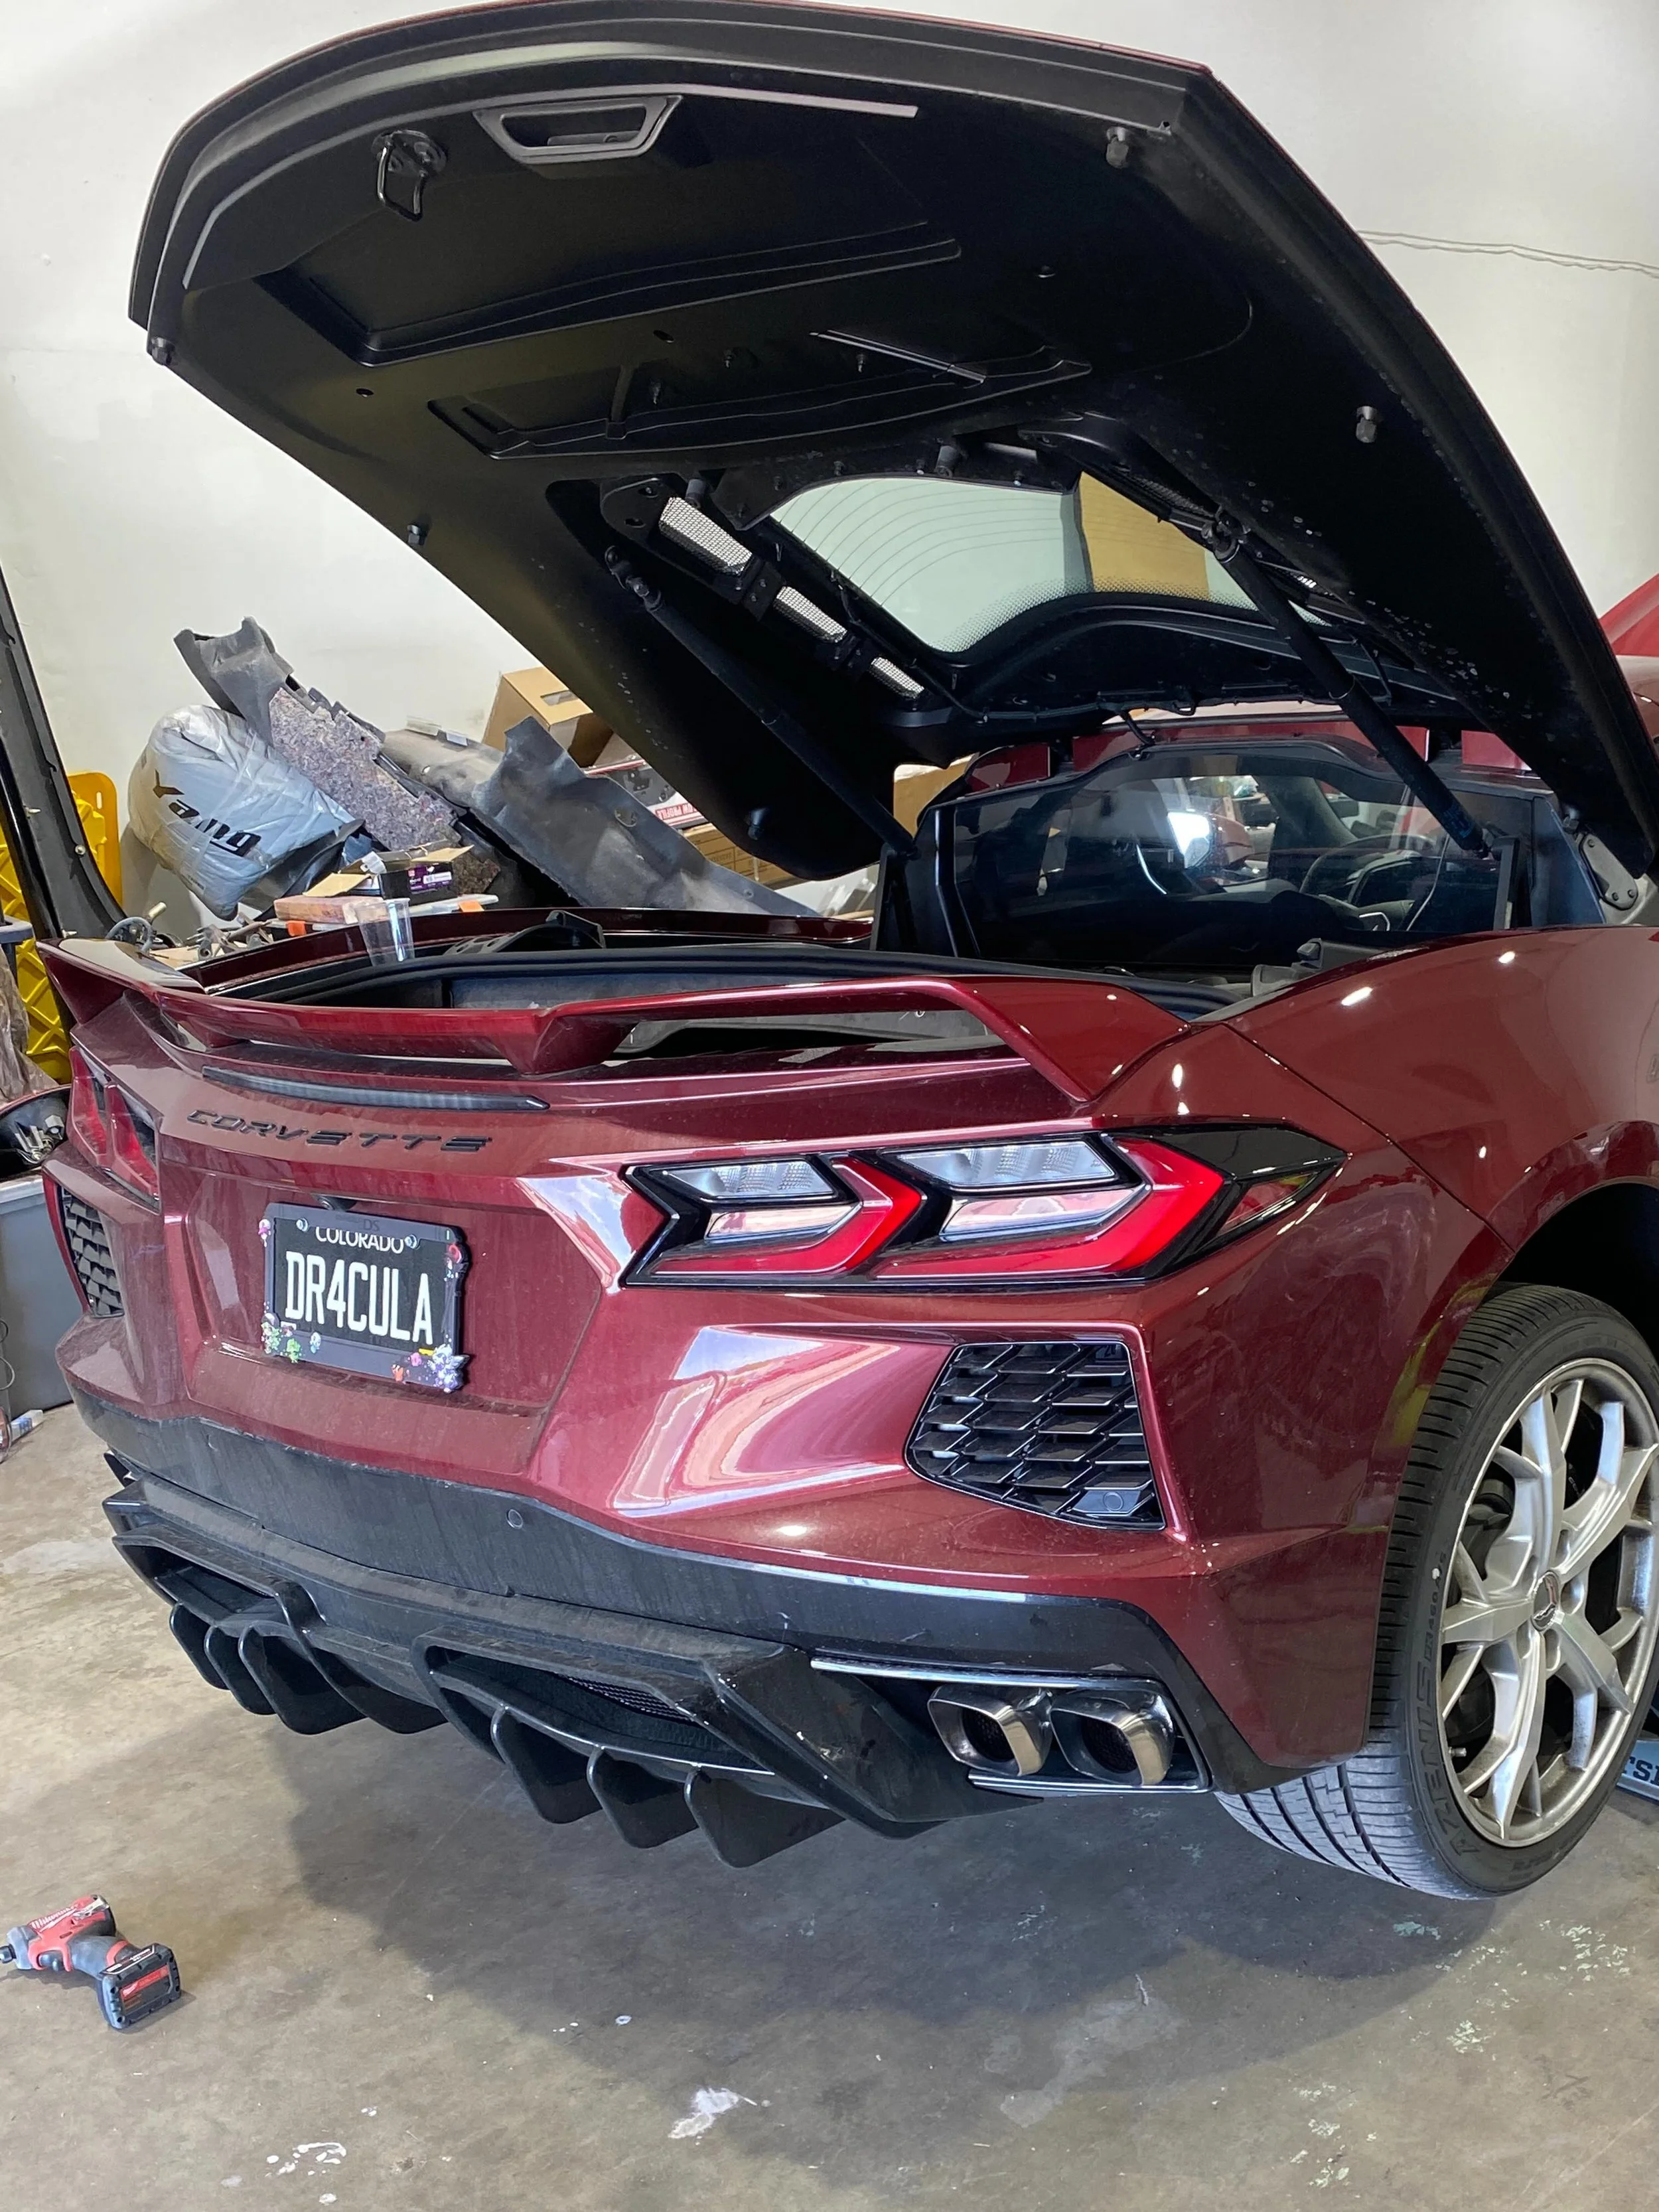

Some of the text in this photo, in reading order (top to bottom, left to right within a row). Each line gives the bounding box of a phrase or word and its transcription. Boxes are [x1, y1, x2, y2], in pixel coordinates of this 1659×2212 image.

[186, 1110, 492, 1151] CORVETTE
[315, 1226, 404, 1254] COLORADO
[285, 1251, 433, 1345] DR4CULA
